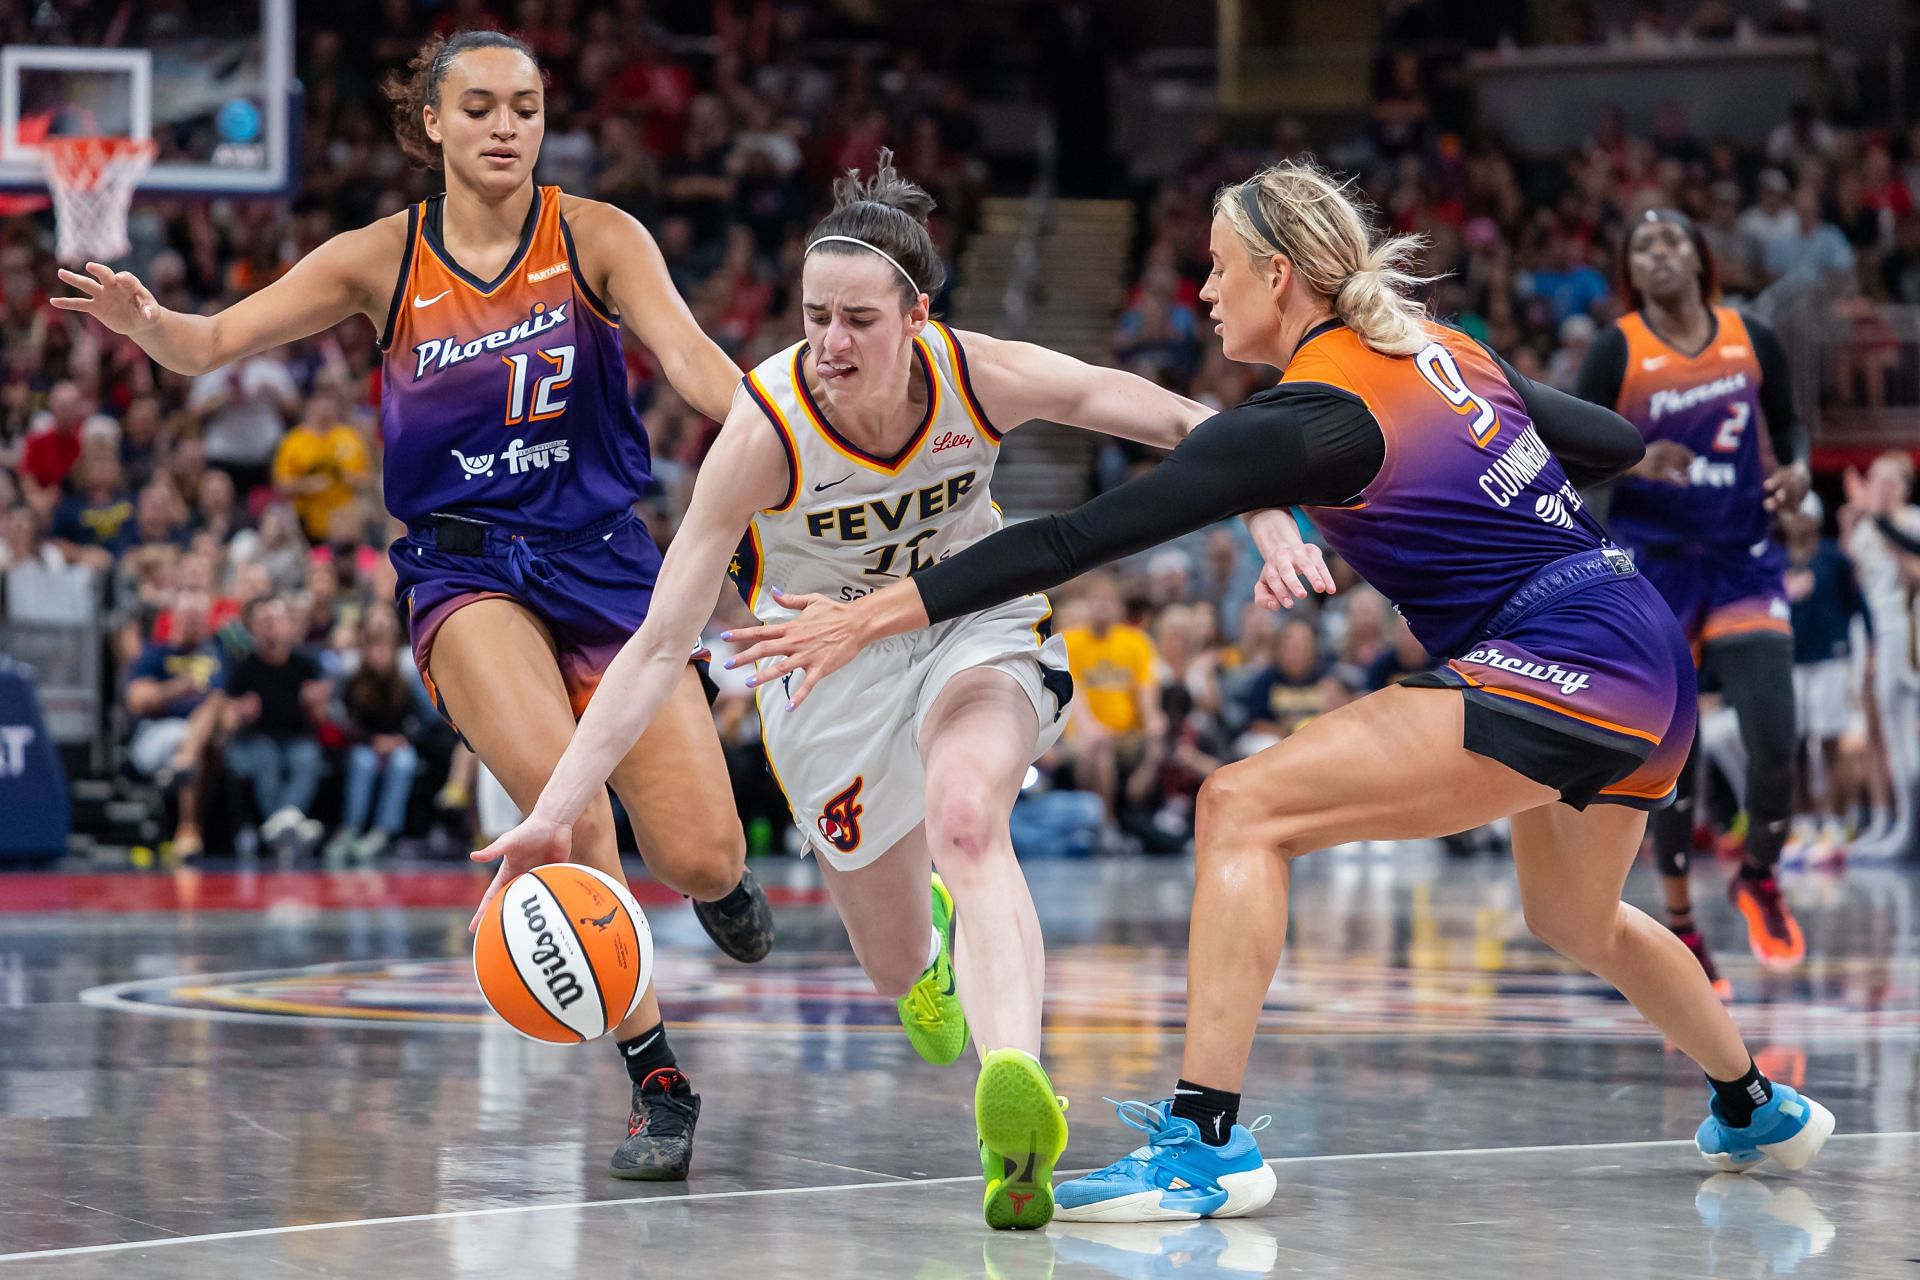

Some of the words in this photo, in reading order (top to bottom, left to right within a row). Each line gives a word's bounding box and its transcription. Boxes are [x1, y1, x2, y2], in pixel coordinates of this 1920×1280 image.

[528, 262, 569, 282] PARTAKE
[413, 302, 568, 382] Phoenix
[502, 345, 576, 425] 12
[1414, 342, 1500, 448] 9
[932, 431, 975, 454] Lilly
[1712, 400, 1751, 453] 2
[804, 469, 977, 541] FEVER
[520, 893, 584, 1012] Wilson
